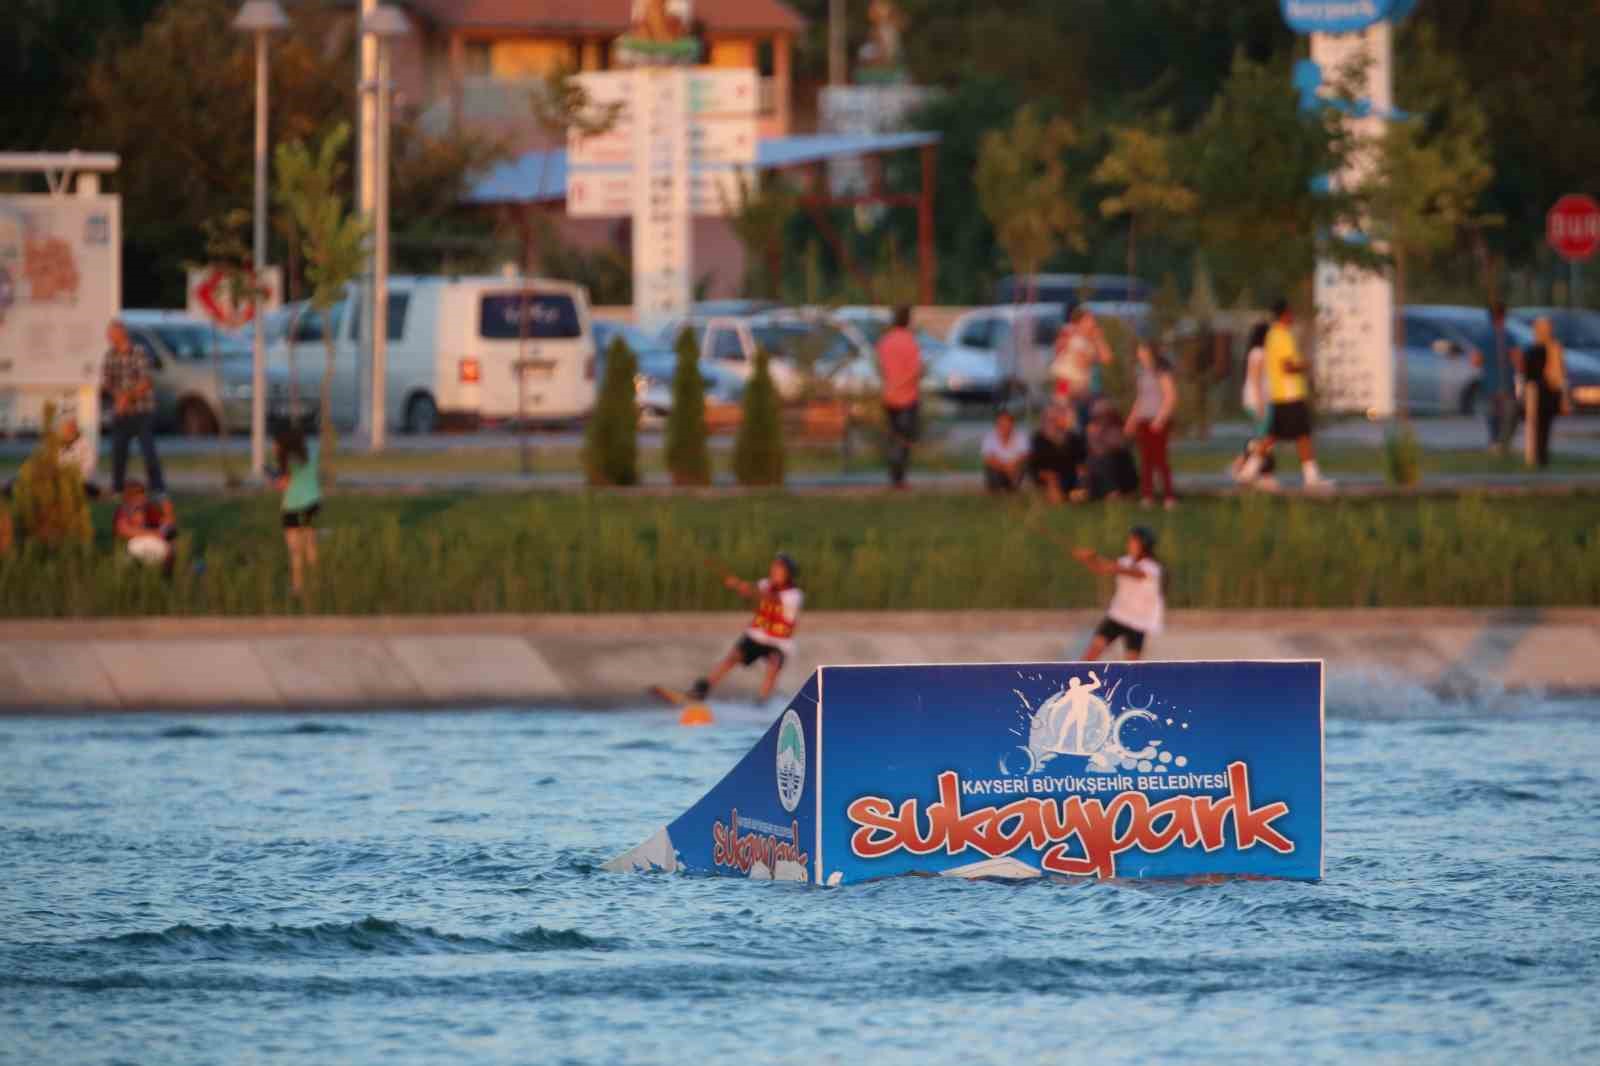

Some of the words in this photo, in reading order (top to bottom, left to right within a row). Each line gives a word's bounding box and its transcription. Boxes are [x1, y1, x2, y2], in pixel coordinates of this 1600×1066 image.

[962, 774, 1028, 795] KAYSERİ
[1033, 773, 1133, 795] BÜYÜKŞEHİR
[1137, 771, 1229, 791] BELEDİYESİ
[847, 761, 1295, 879] sukaypark
